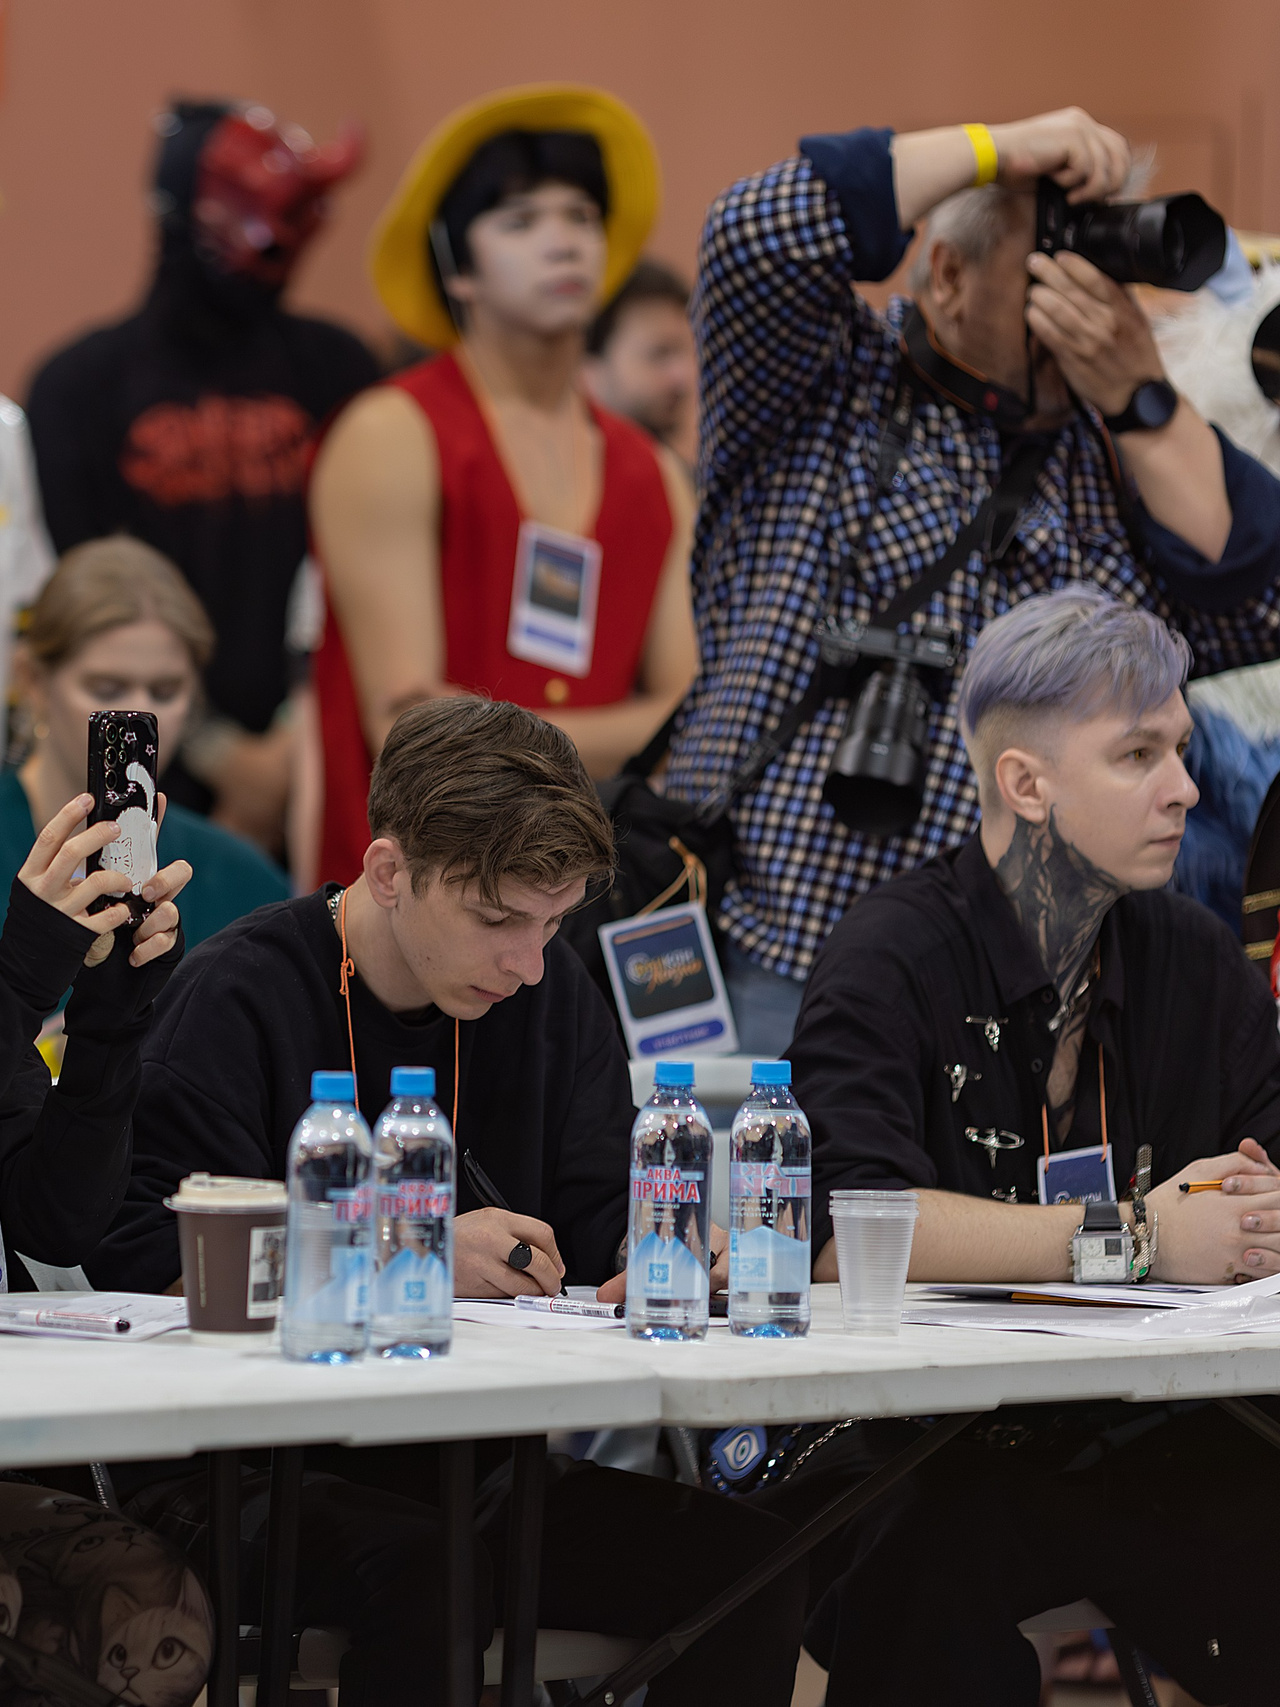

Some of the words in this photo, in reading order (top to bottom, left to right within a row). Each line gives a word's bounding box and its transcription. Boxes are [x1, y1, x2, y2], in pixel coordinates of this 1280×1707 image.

[647, 1168, 681, 1181] АКВА
[633, 1181, 699, 1201] ПРИМА
[380, 1196, 450, 1216] ПРИМА
